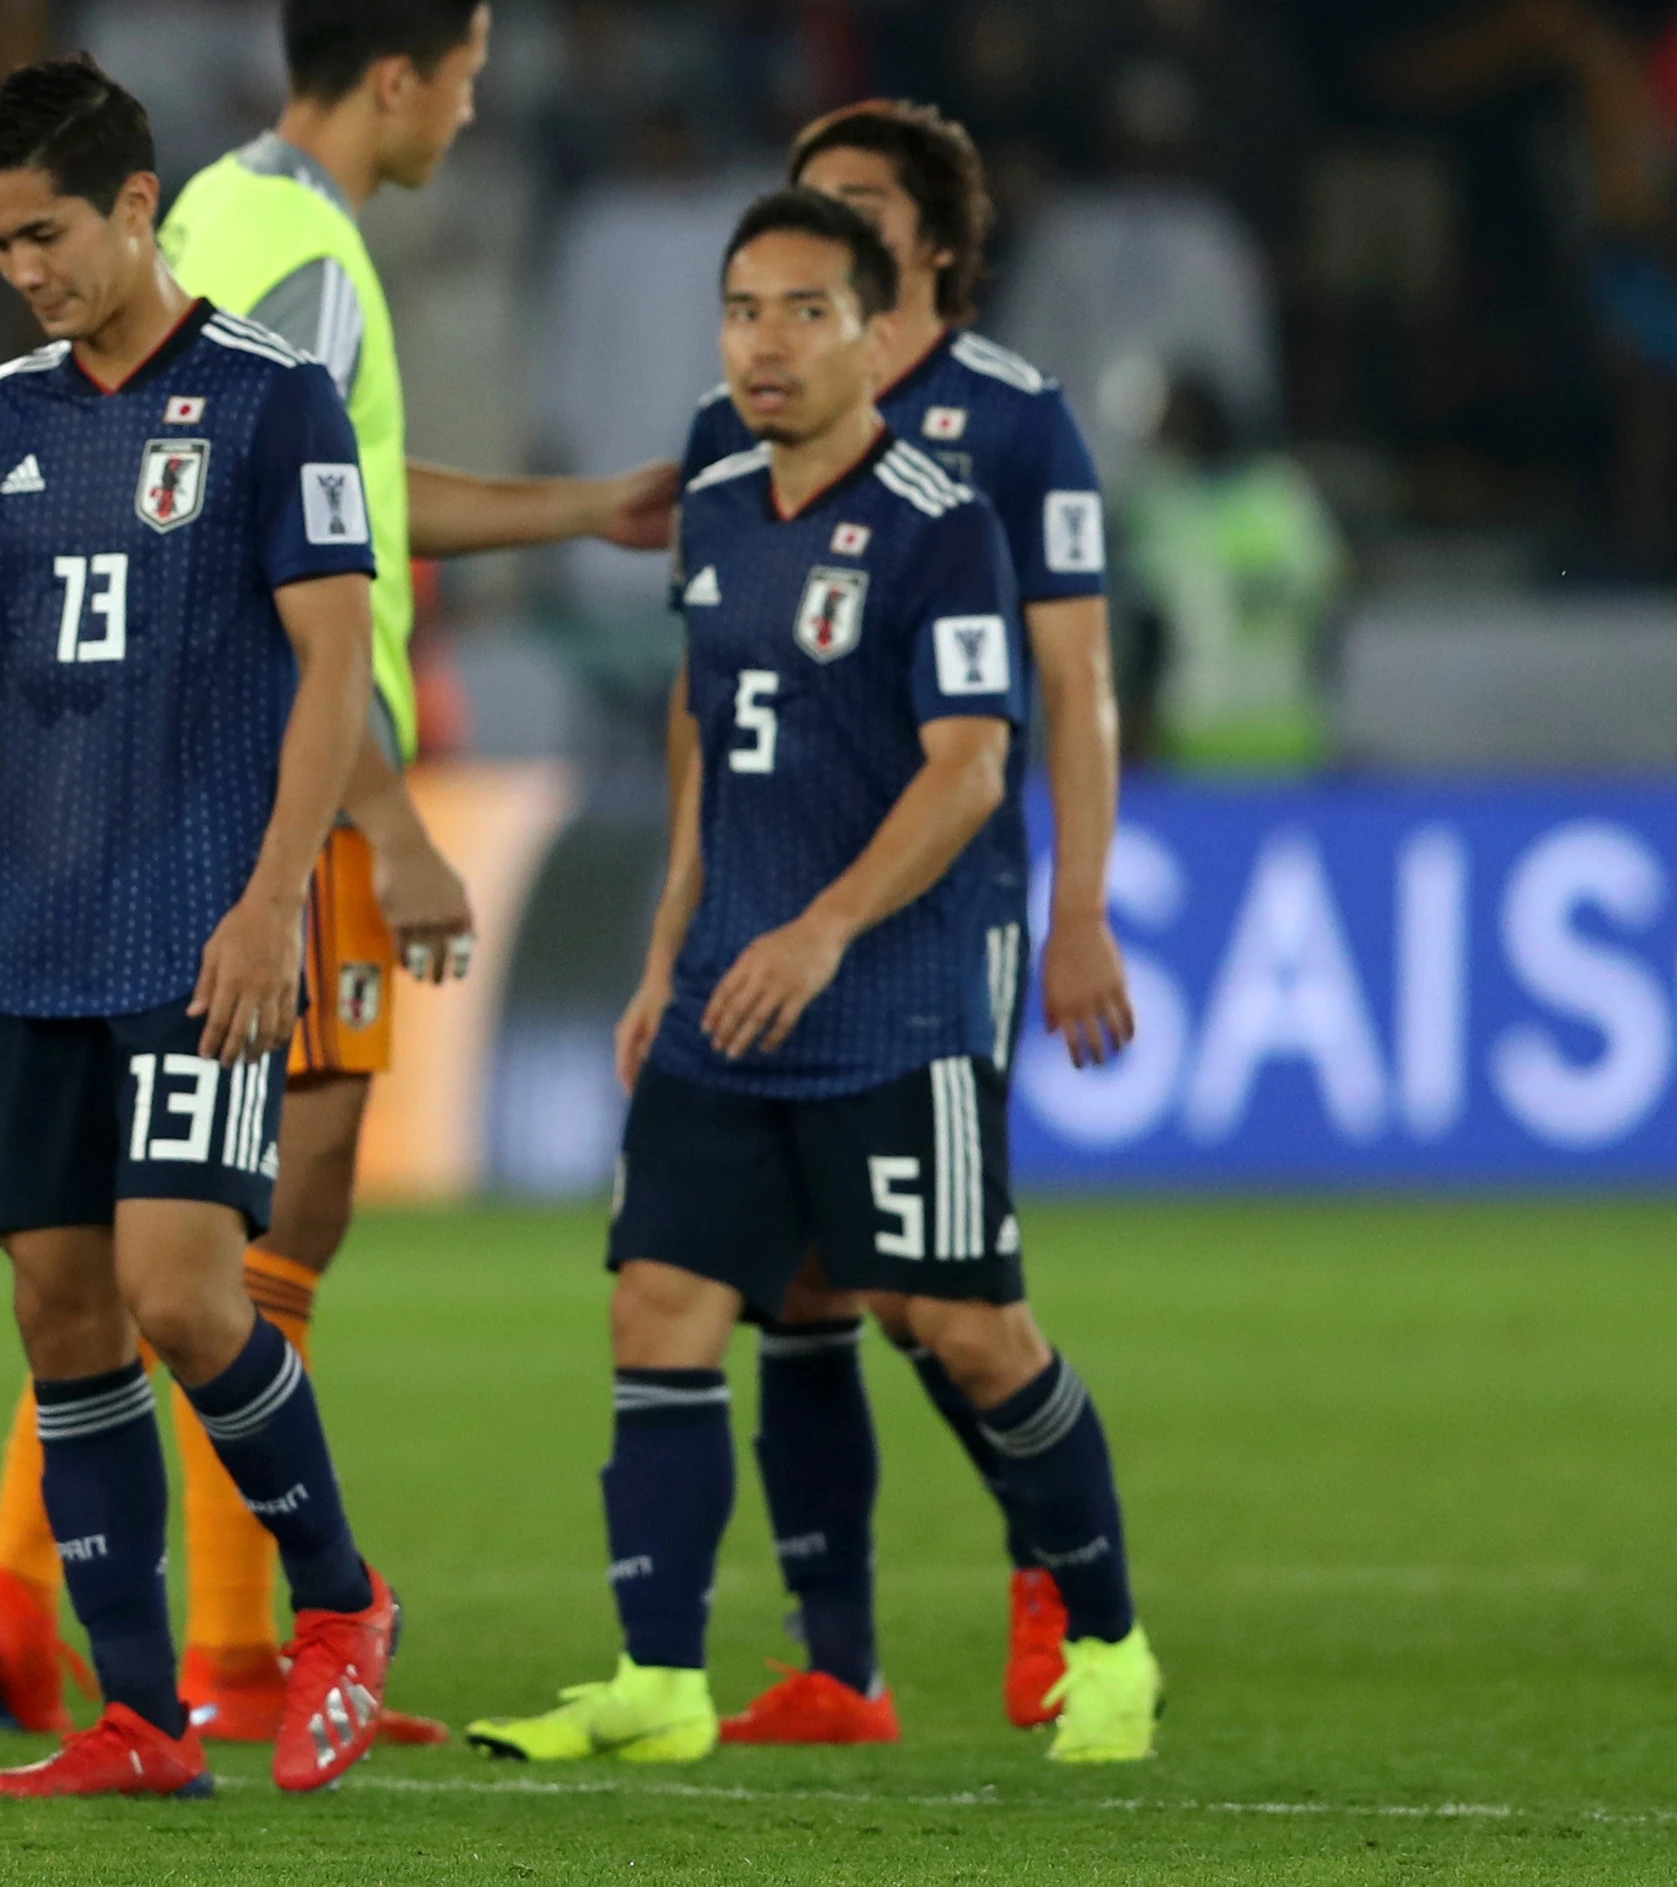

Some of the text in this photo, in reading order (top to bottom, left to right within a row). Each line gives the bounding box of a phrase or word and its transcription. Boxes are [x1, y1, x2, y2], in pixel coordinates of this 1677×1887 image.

[54, 553, 129, 664] 13
[728, 669, 780, 774] 5
[128, 1052, 221, 1163] 13
[867, 1155, 926, 1261] 5
